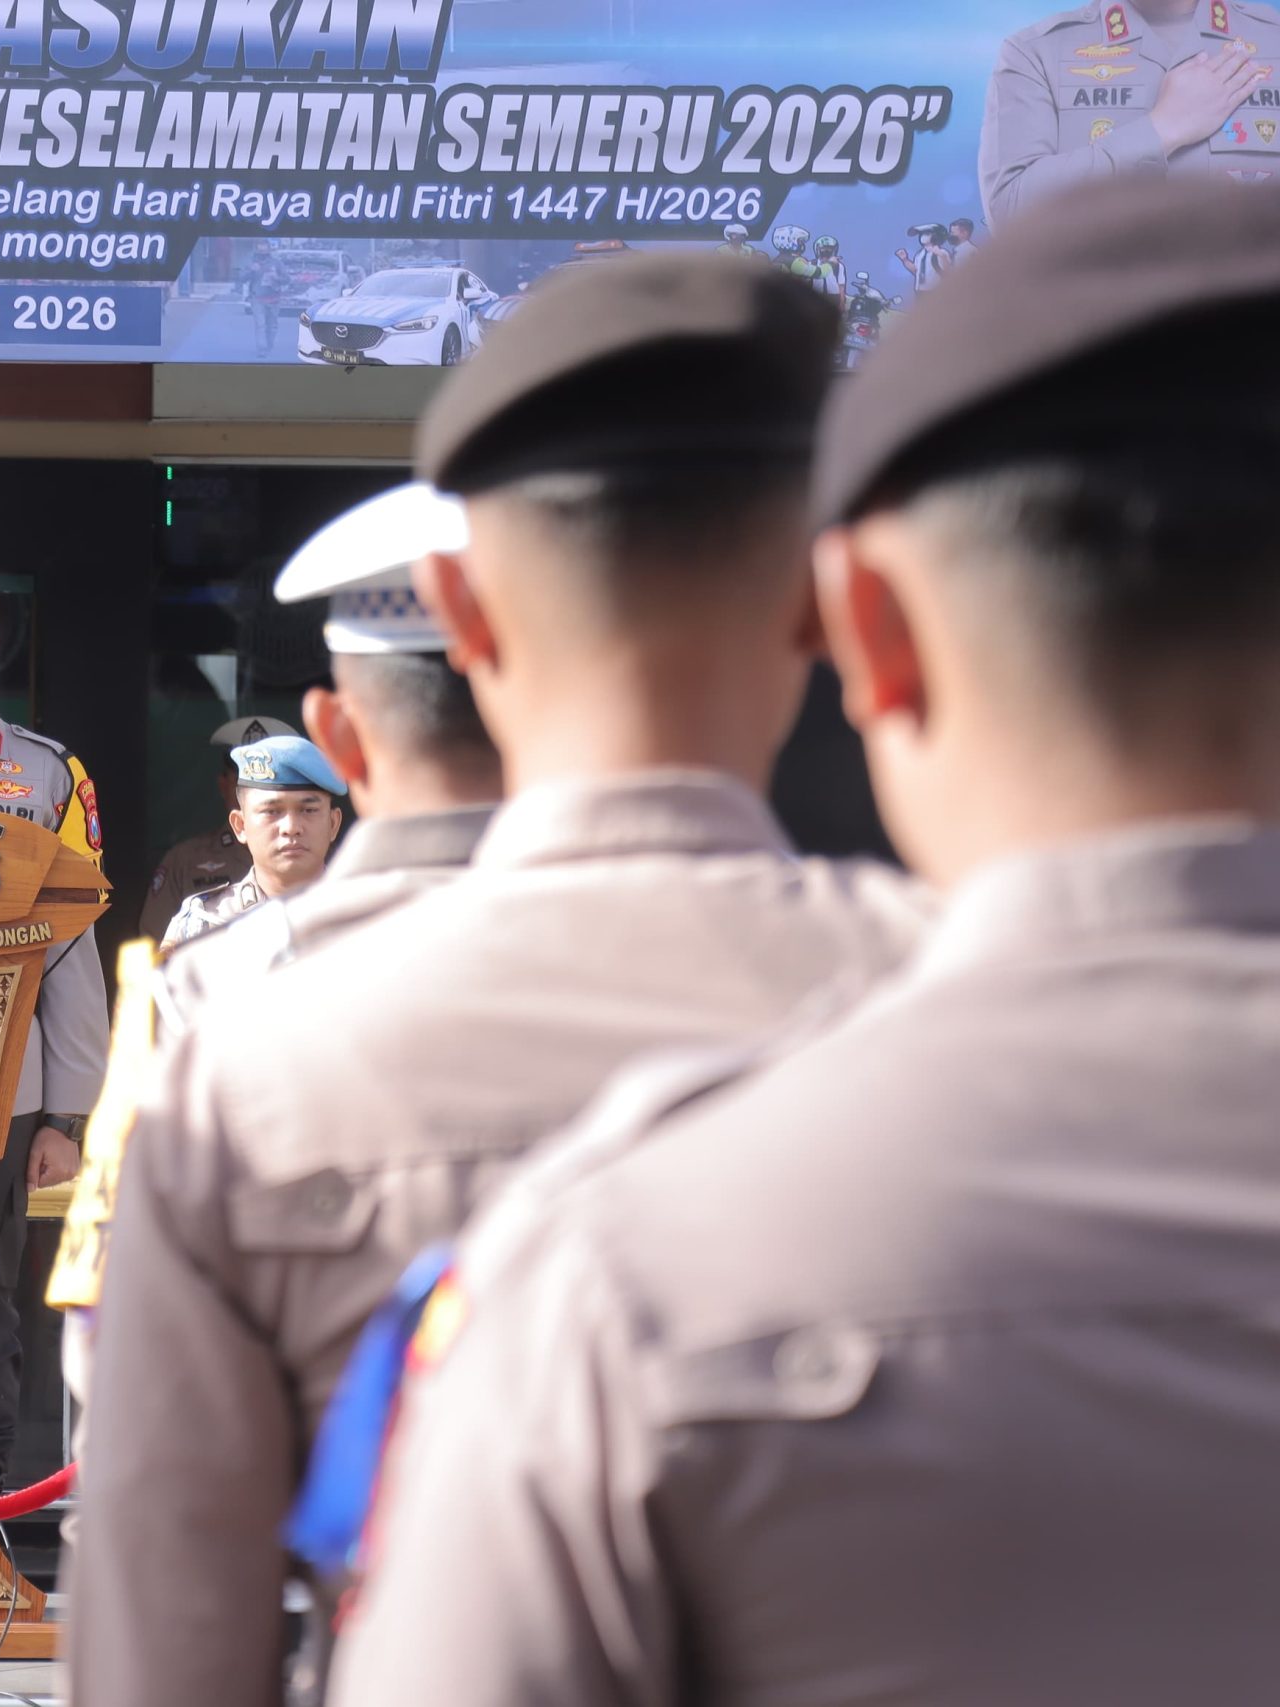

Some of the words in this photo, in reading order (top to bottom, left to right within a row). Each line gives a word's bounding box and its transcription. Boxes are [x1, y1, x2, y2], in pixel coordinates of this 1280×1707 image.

[1073, 87, 1133, 107] ARIF
[1247, 89, 1280, 107] LRI
[436, 92, 715, 175] SEMERU
[112, 181, 201, 217] Hari
[210, 183, 312, 226] Raya
[323, 184, 401, 219] Idul
[411, 185, 495, 220] Fitri
[506, 186, 608, 221] 1447
[616, 186, 762, 222] H/2026
[12, 295, 117, 331] 2026
